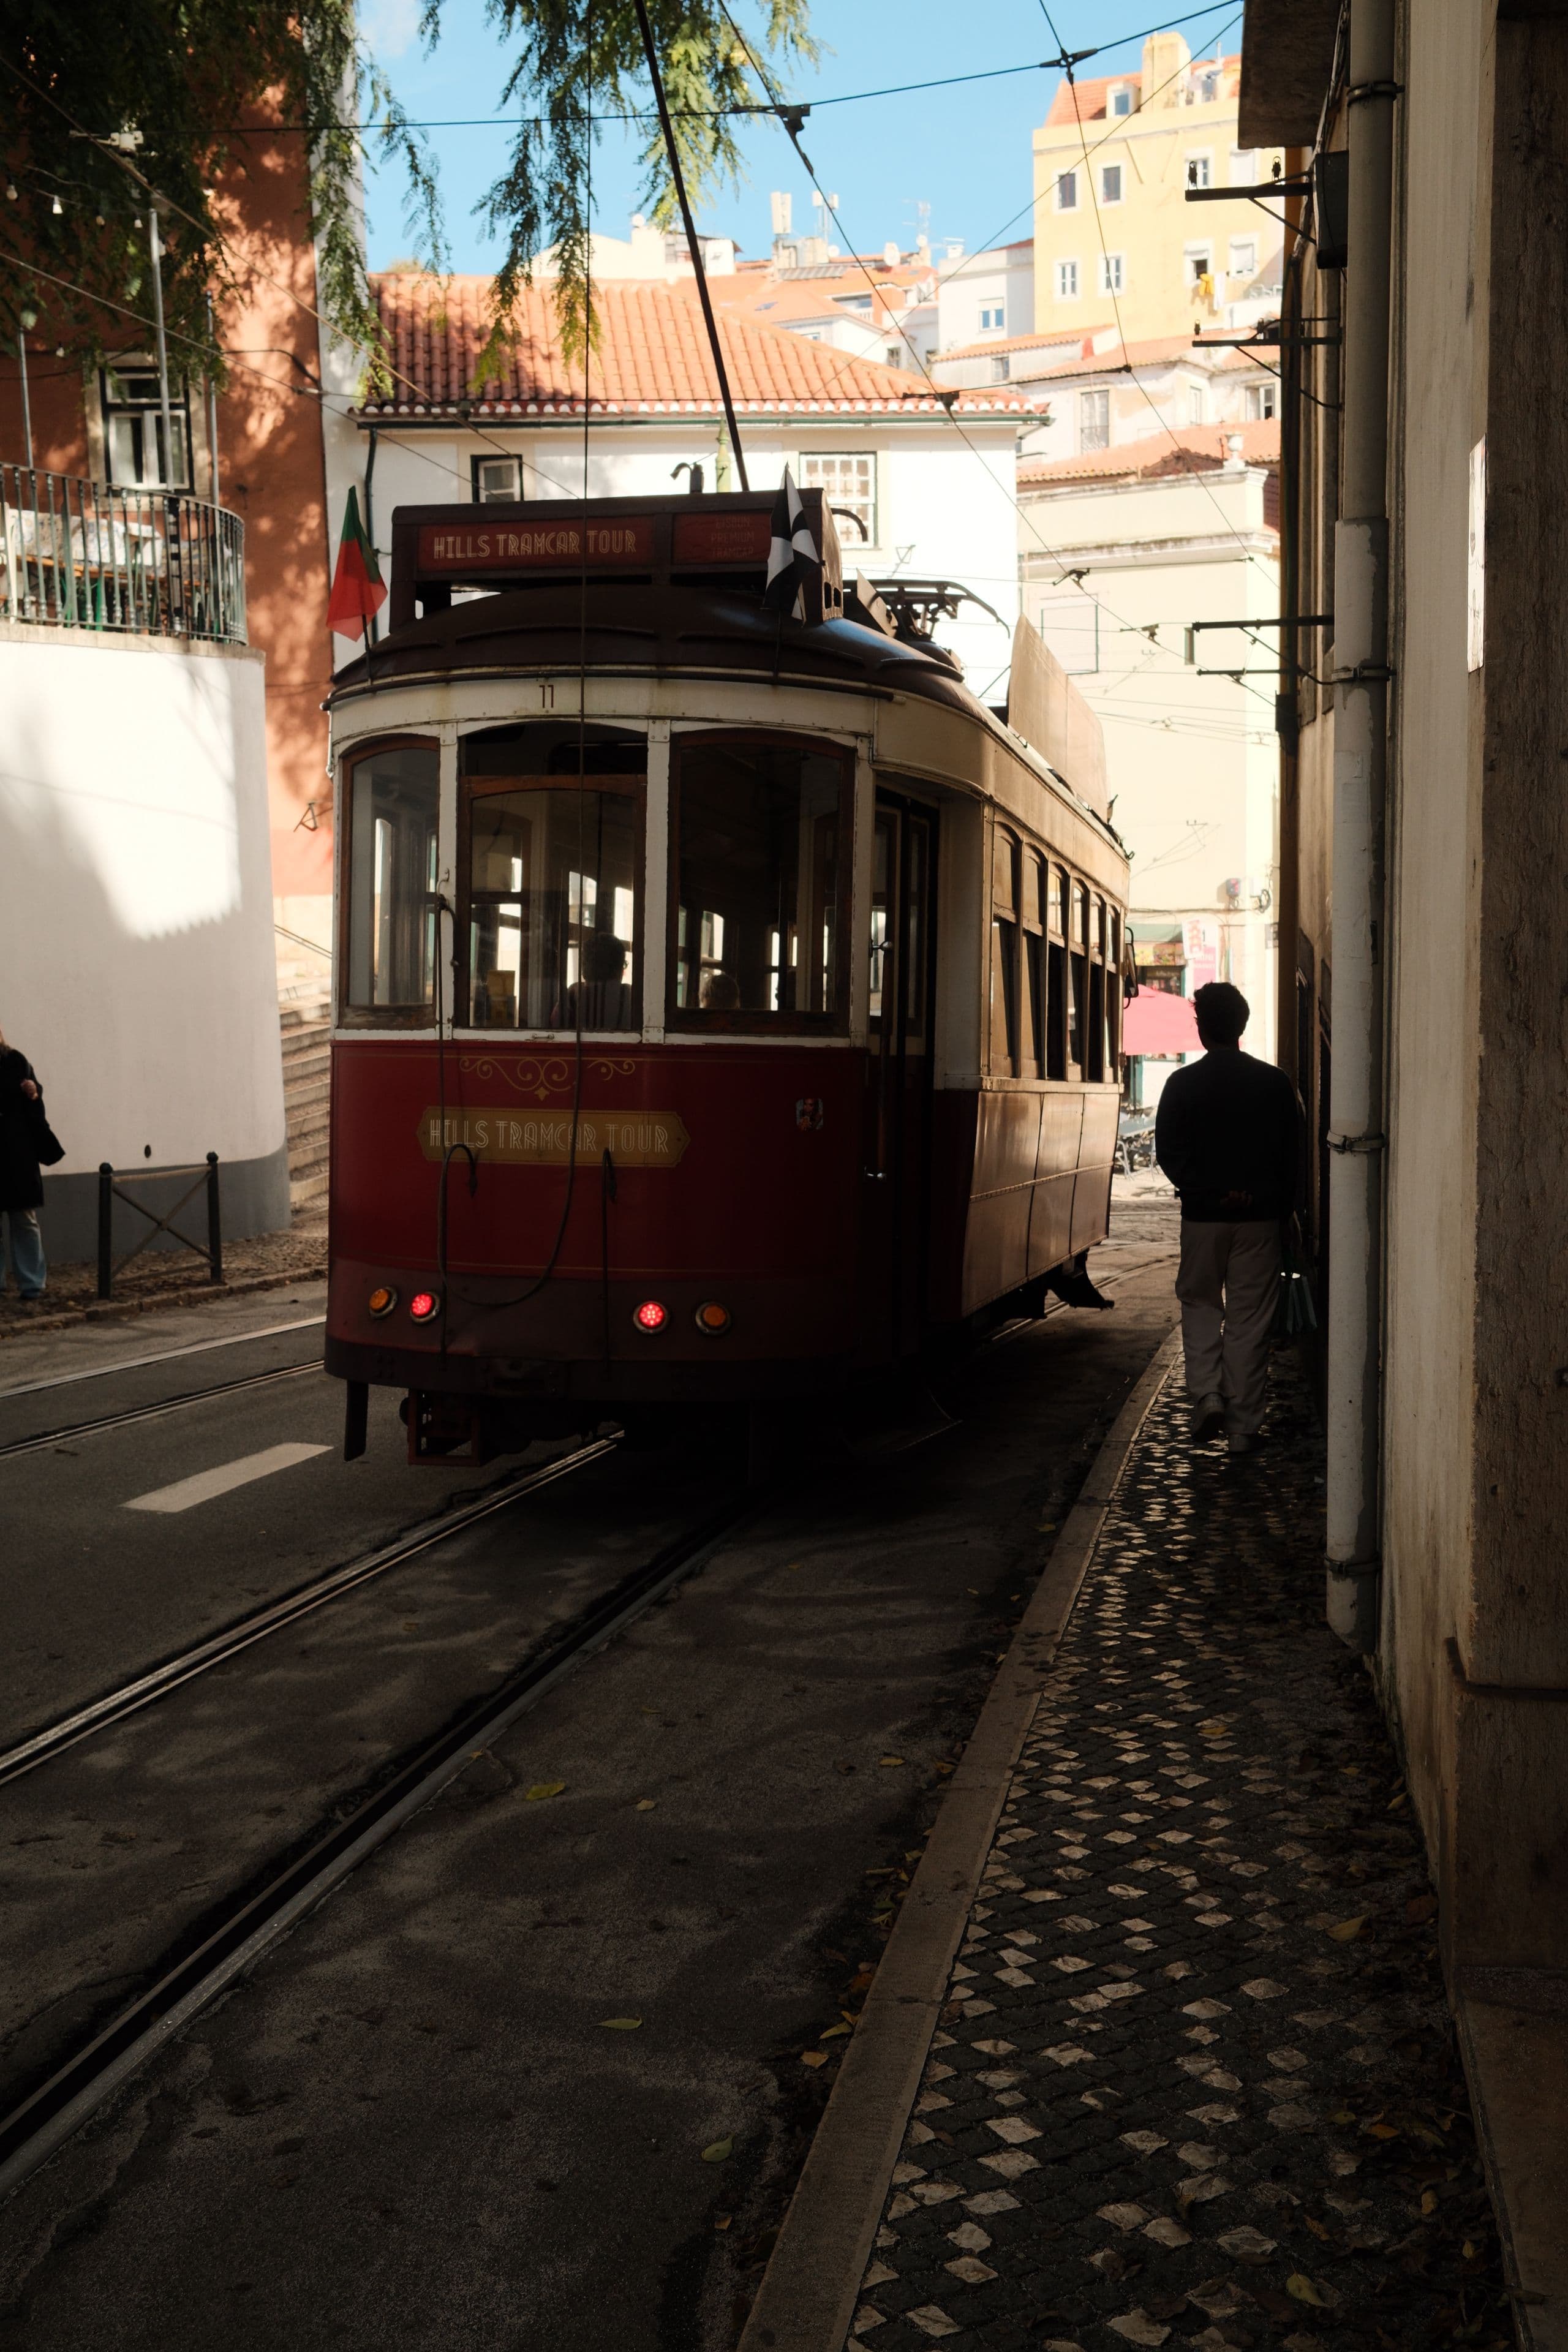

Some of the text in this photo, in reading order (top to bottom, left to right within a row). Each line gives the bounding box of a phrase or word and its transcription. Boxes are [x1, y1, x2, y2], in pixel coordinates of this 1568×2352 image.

[434, 529, 637, 559] HILLS TRAMCAR TOUR
[710, 531, 755, 544] PREMIUM
[539, 684, 554, 709] 11
[429, 1119, 669, 1153] HILLS TRAMCAR TOUR
